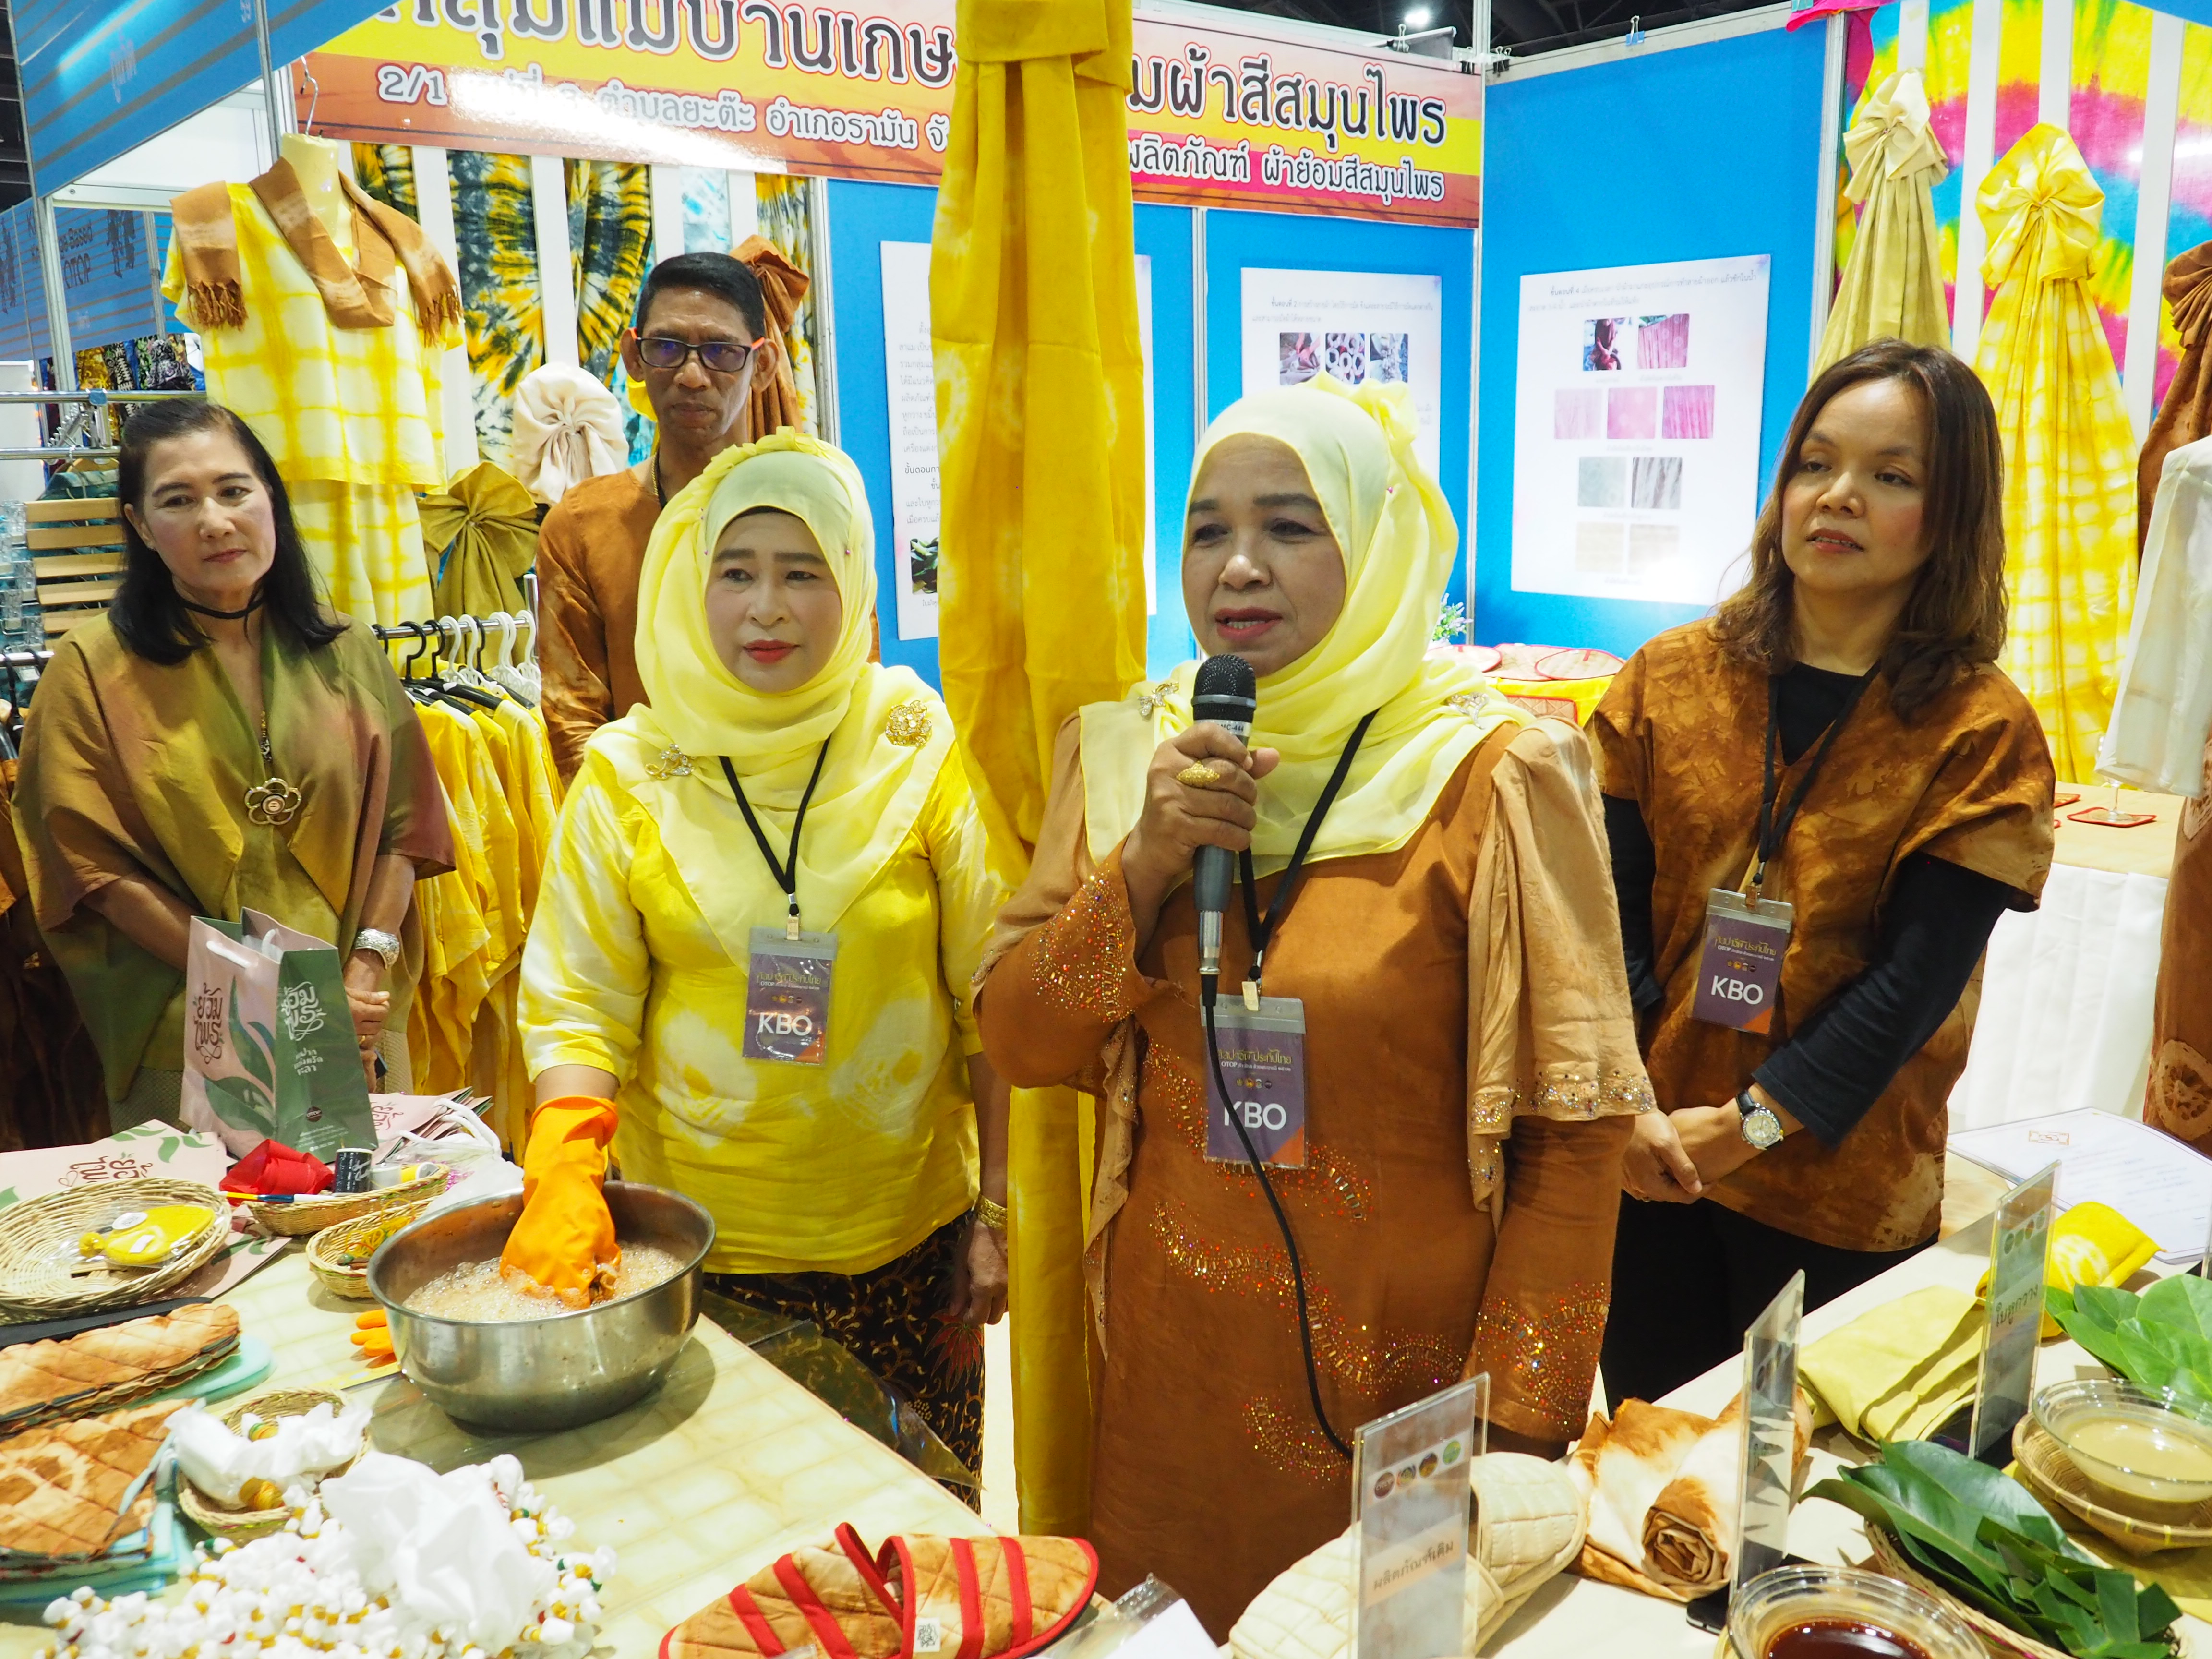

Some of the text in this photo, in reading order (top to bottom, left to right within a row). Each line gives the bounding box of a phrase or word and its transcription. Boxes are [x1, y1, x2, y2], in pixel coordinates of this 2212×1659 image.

[383, 70, 442, 99] 2/1
[770, 102, 914, 144] อำเภอรามัน
[1264, 150, 1443, 204] ผ้าย้อมสีสมุนไพร
[1711, 975, 1764, 1005] KBO
[757, 1012, 812, 1036] KBO
[1224, 1101, 1287, 1130] KBO
